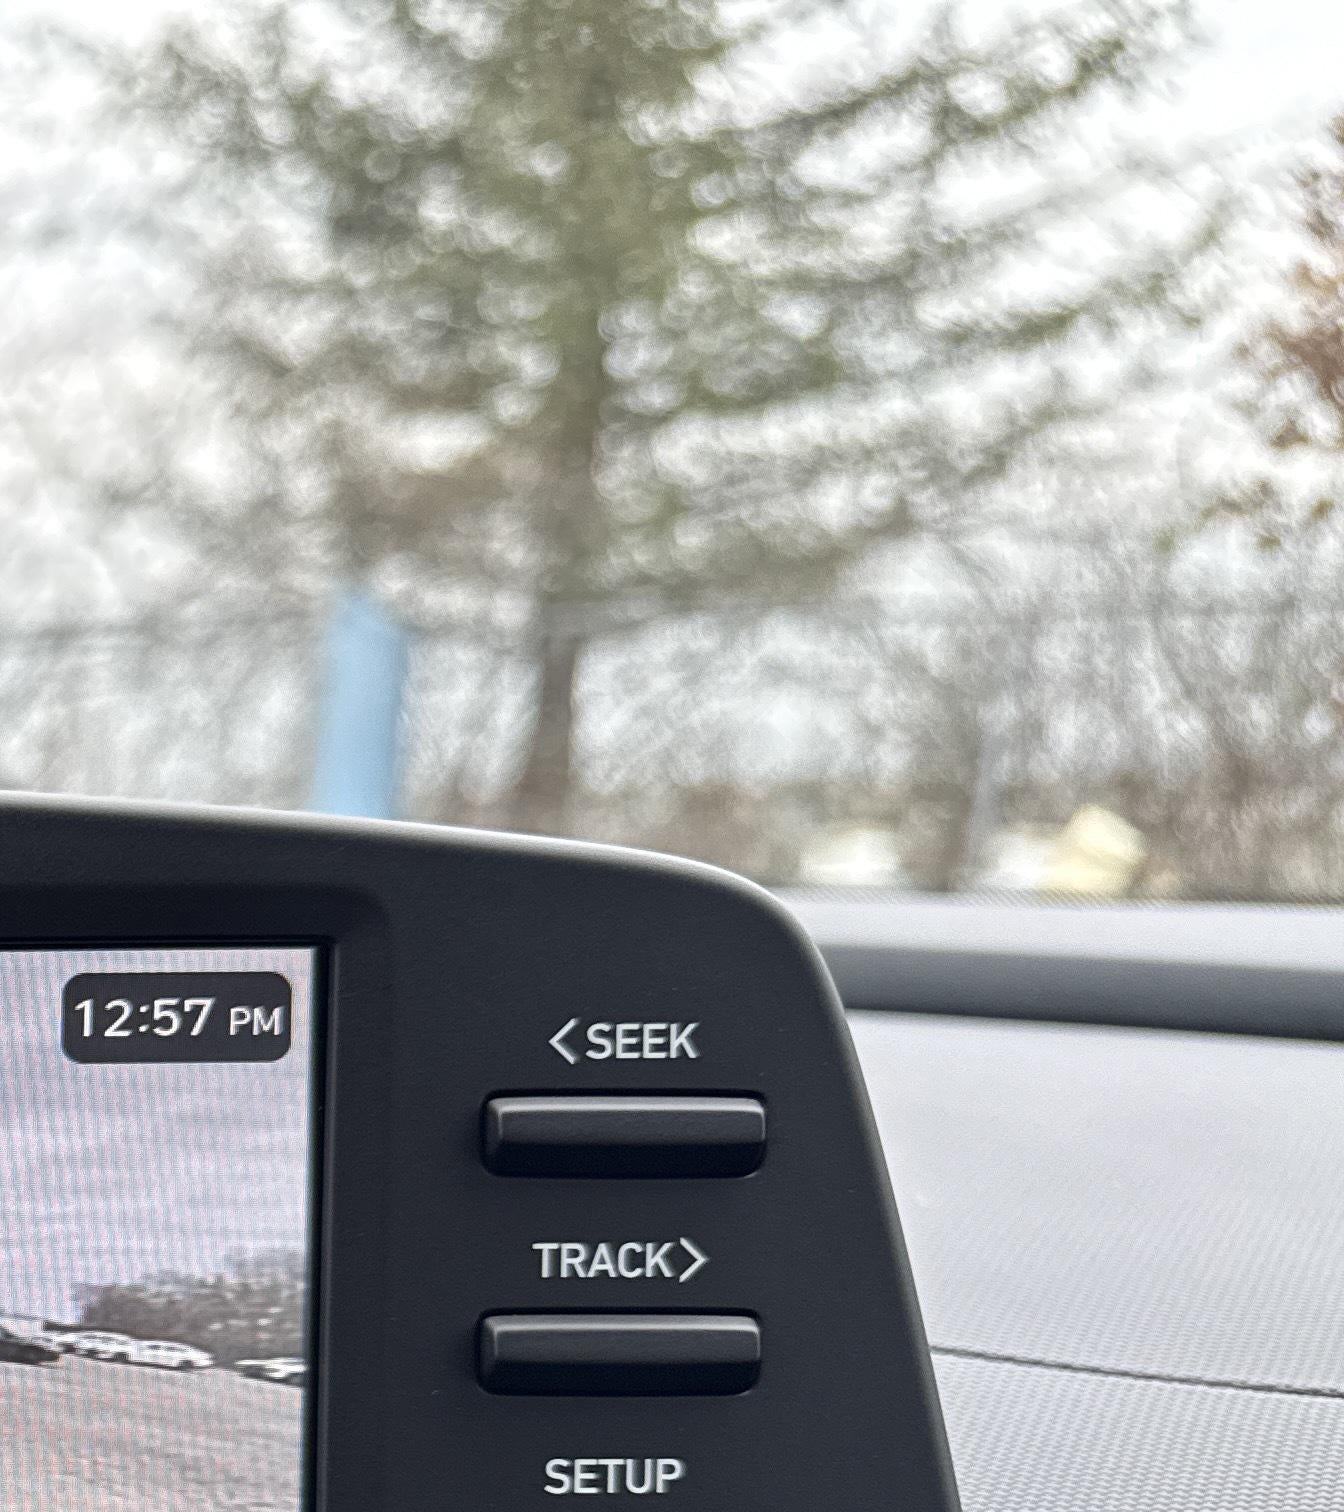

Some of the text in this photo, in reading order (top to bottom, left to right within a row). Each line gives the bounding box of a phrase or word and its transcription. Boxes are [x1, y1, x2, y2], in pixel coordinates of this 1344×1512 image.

[75, 997, 284, 1039] 12:57 PM
[543, 1458, 686, 1496] SETUP
